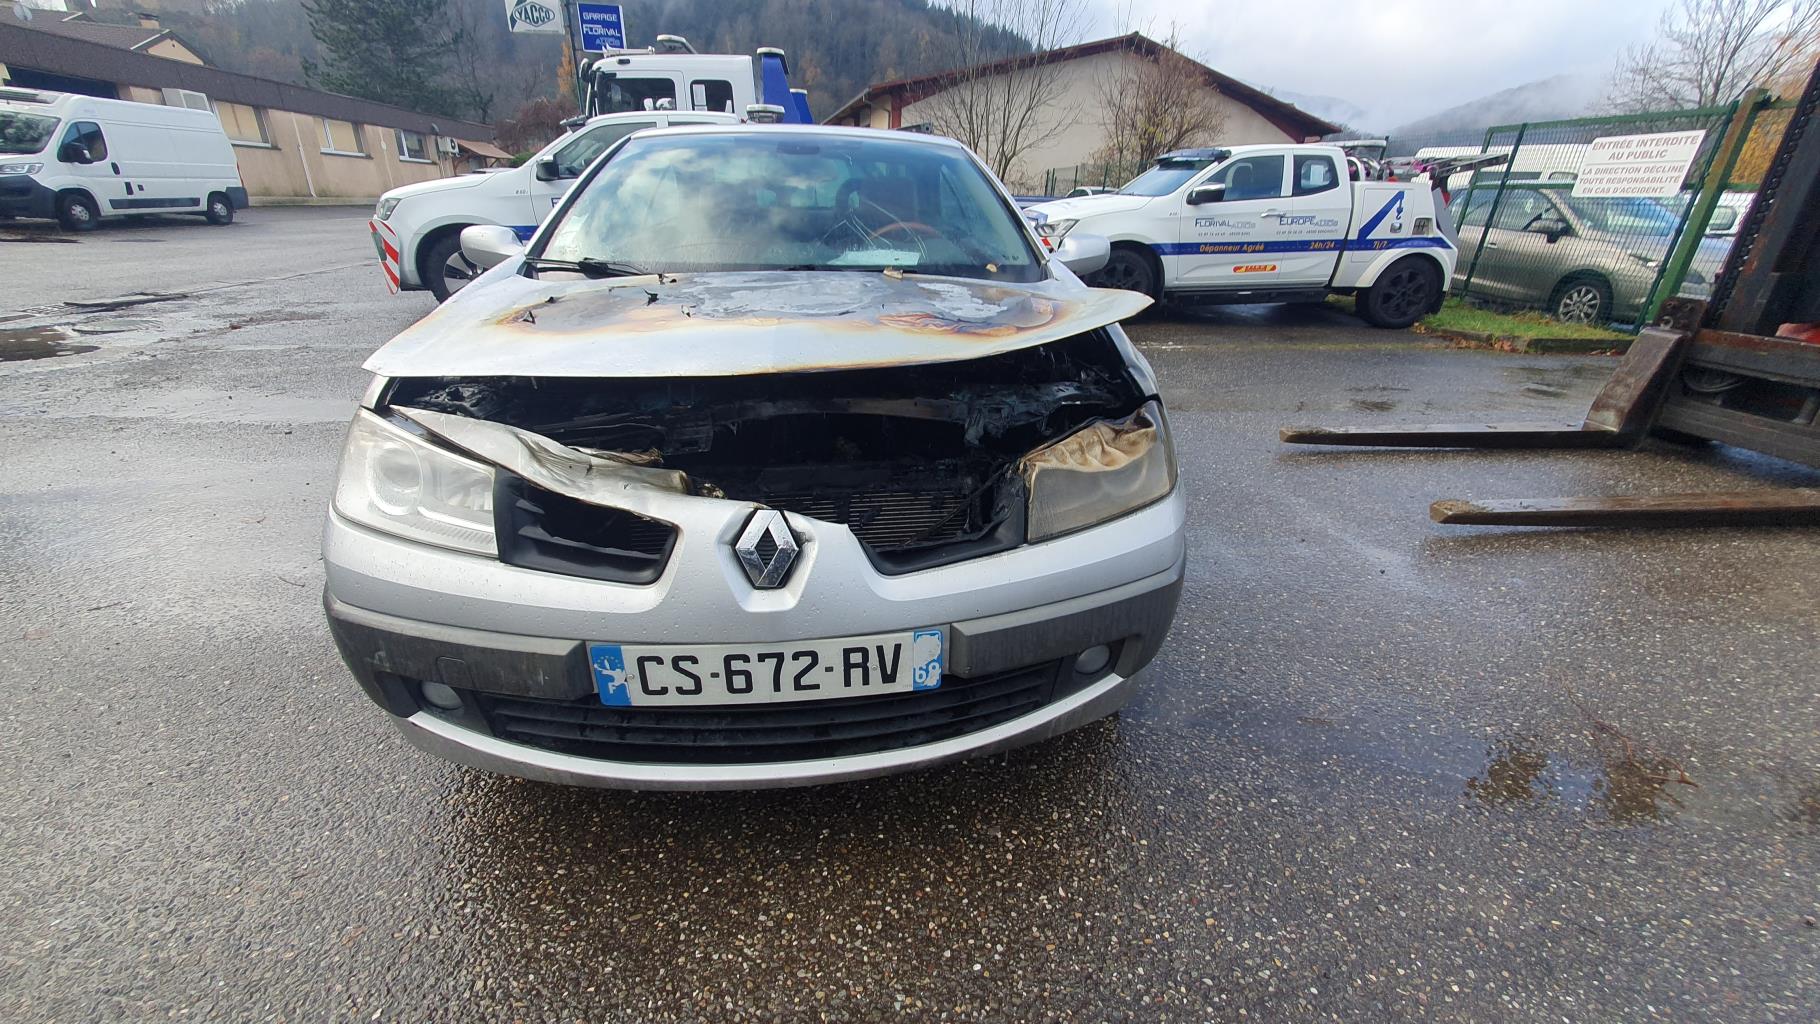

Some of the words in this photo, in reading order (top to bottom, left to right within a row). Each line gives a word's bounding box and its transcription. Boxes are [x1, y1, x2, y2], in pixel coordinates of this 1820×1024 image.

[516, 5, 550, 24] YACCO
[583, 12, 618, 21] GARAGE
[583, 24, 620, 36] FLORIVAL
[1592, 139, 1633, 151] ENTRÉE
[1636, 135, 1699, 148] INTERDITE
[1608, 151, 1624, 161] AU
[1626, 149, 1668, 160] PUBLIC
[1582, 167, 1593, 176] LA
[1594, 166, 1640, 175] DIRECTION
[1195, 217, 1232, 228] FLORIVAL
[1200, 244, 1241, 253] Dépanneur
[1242, 243, 1264, 253] Agréé
[636, 643, 902, 696] CS-672-RV
